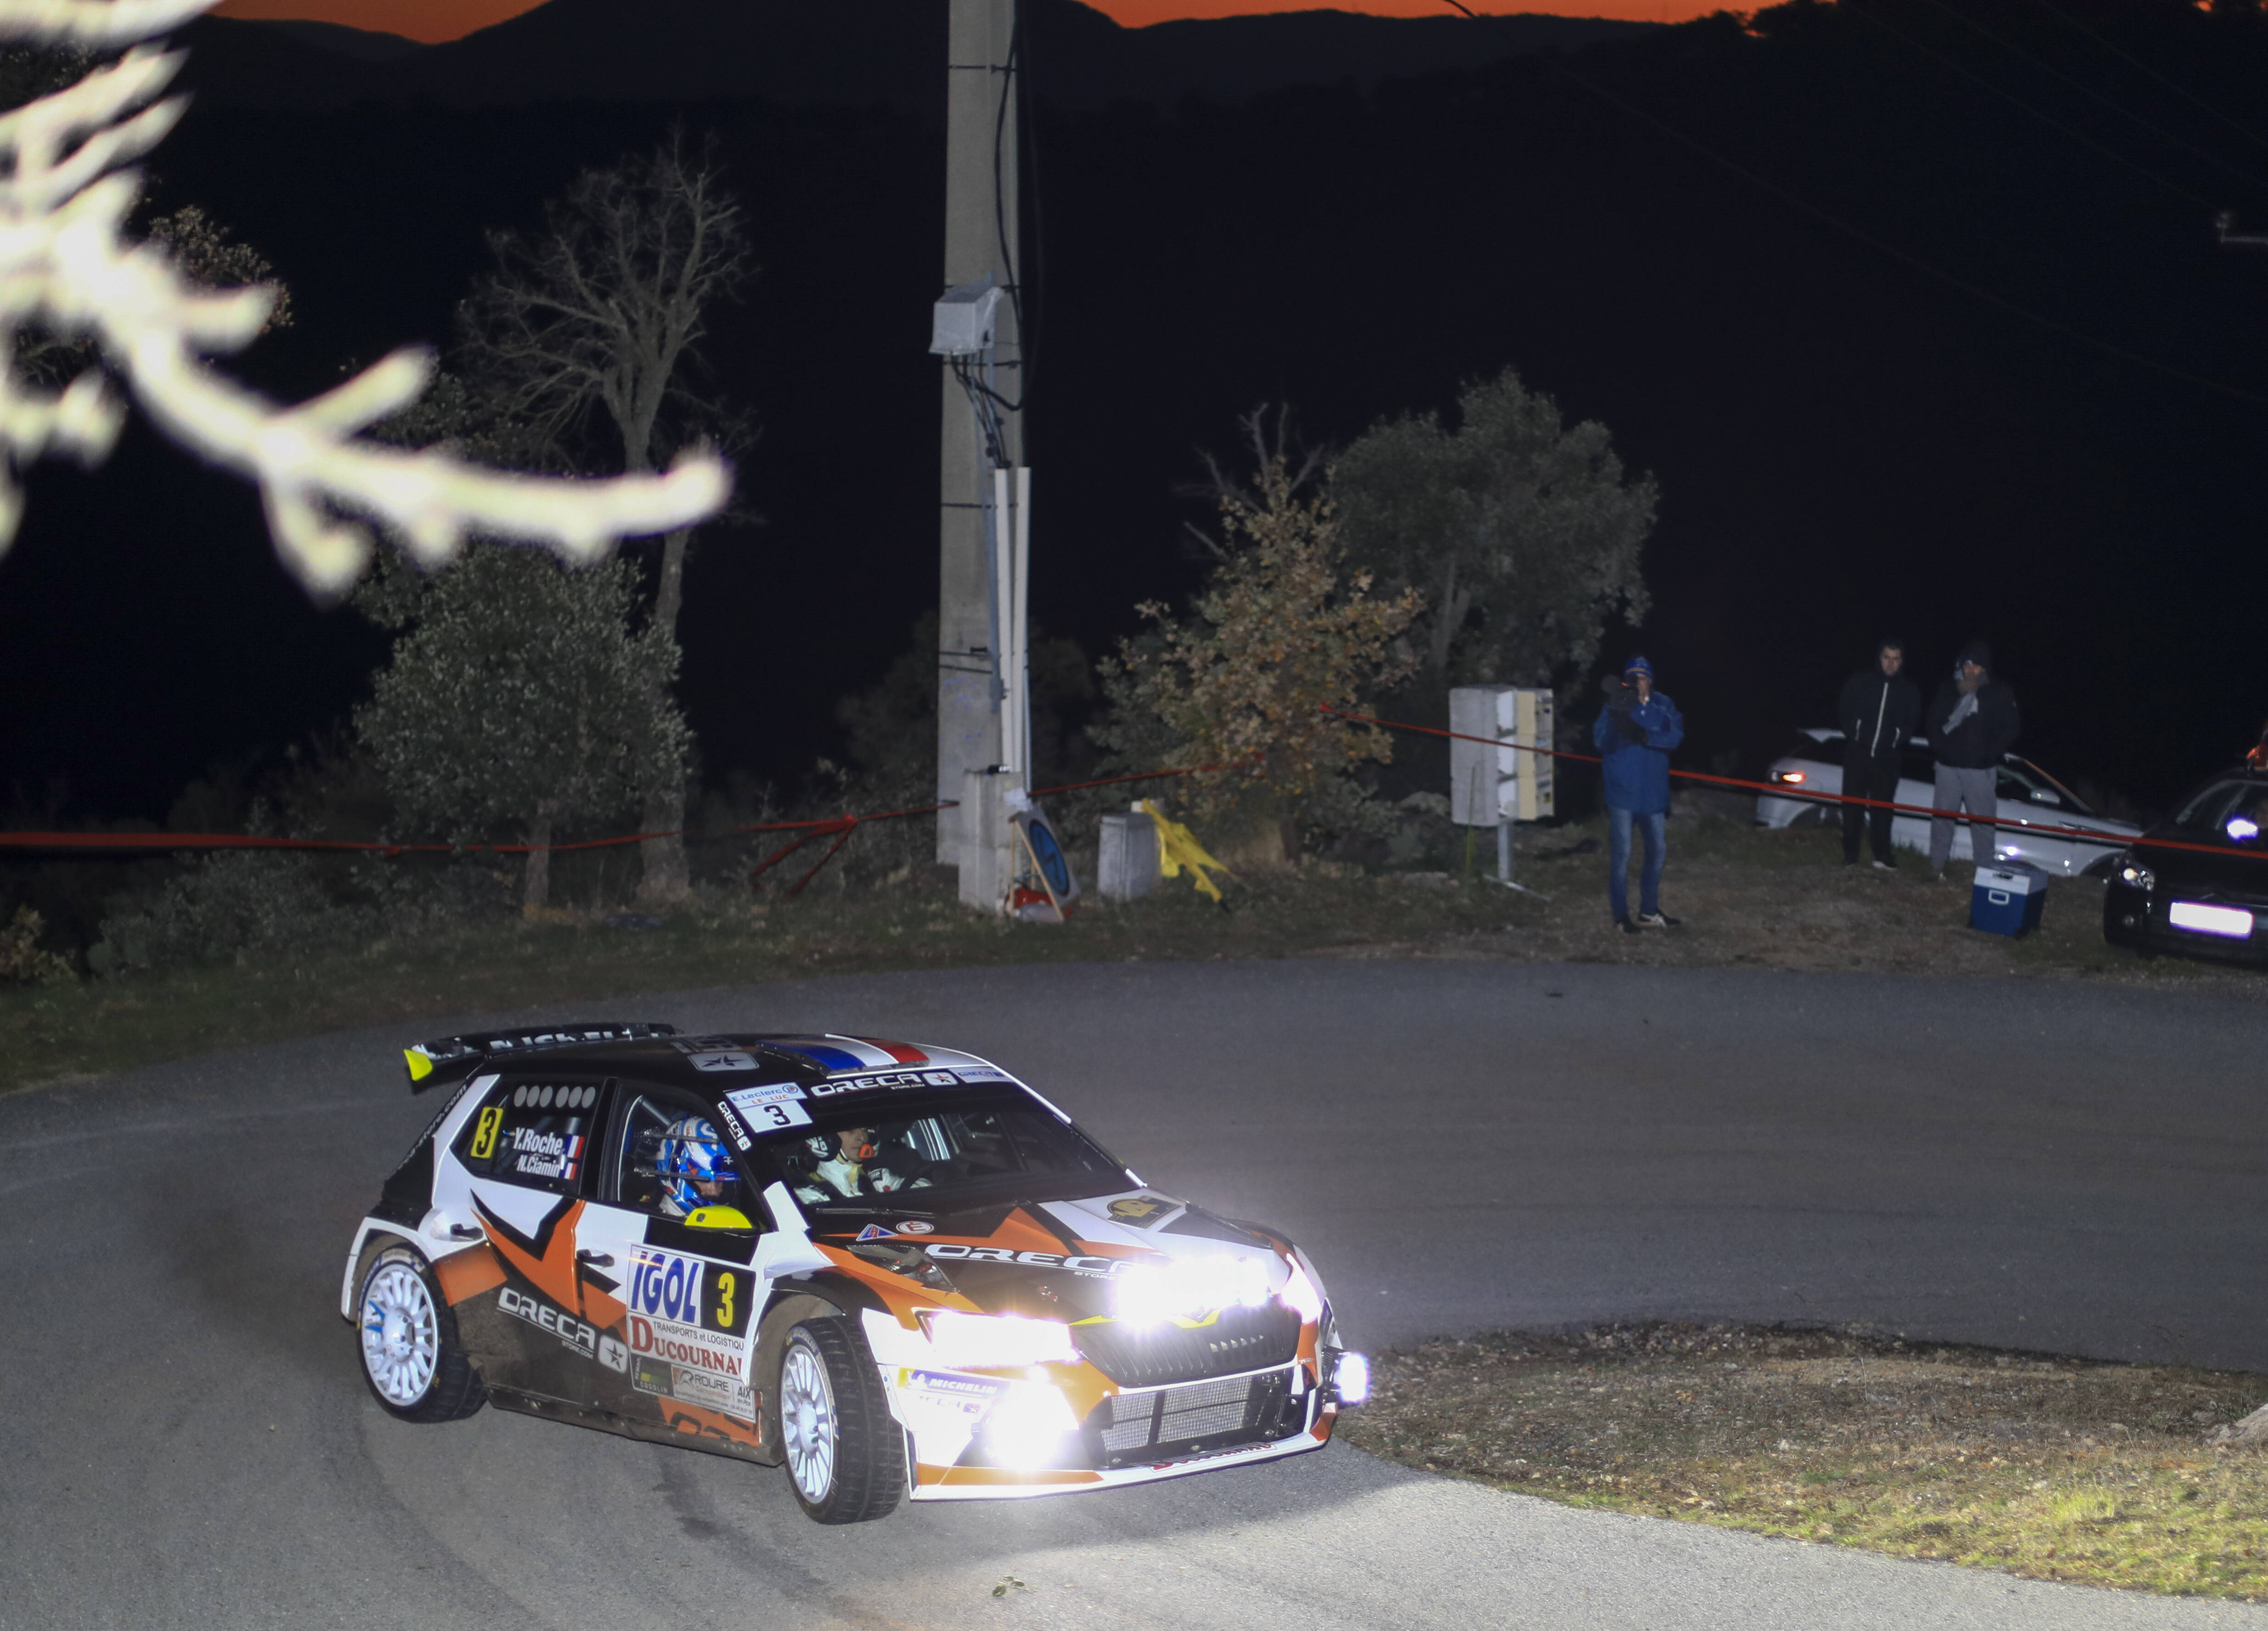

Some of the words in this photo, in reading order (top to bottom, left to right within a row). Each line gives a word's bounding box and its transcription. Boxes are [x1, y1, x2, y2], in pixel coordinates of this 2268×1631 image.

[731, 1088, 782, 1102] E.Leclerc
[810, 1073, 921, 1097] ORECA
[717, 1101, 745, 1138] ORECA
[763, 1105, 791, 1126] 3
[476, 1108, 496, 1156] 3
[513, 1127, 563, 1155] Y.Roche
[1074, 1271, 1115, 1281] STORE
[717, 1272, 734, 1327] 3
[498, 1287, 595, 1349] ORECA
[630, 1315, 742, 1375] DUCOURNA
[654, 1321, 698, 1339] TRANSPORTS
[699, 1333, 706, 1342] et
[706, 1335, 744, 1351] LOGISTIQU
[694, 1374, 729, 1392] ROURE
[737, 1386, 750, 1400] AIX
[929, 1378, 998, 1395] MICHELIN
